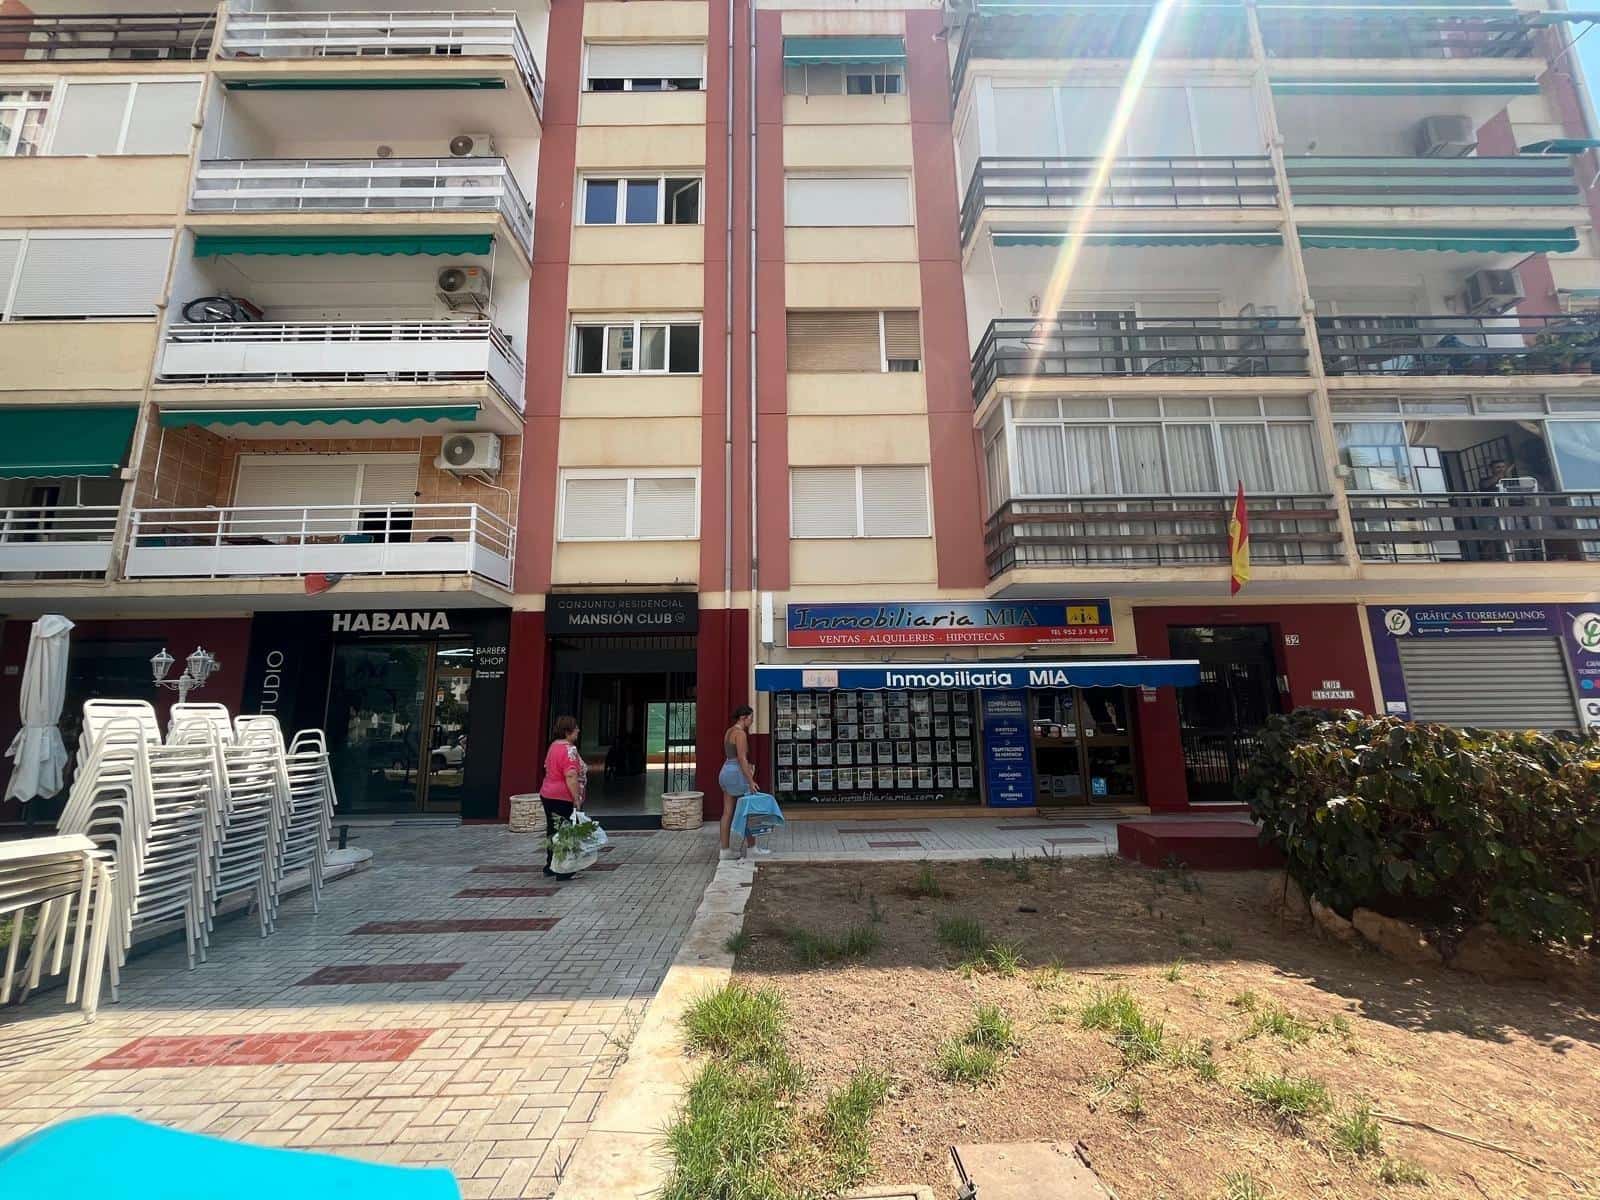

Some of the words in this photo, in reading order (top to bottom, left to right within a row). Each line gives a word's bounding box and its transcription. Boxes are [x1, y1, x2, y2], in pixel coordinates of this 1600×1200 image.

[558, 600, 616, 610] CONJUNTO
[618, 599, 685, 609] RESIDENCIAL
[568, 610, 634, 625] MANSIÓN
[636, 613, 673, 625] CLUB
[794, 607, 974, 630] Inmobiliaria
[984, 607, 1037, 626] MIA
[1415, 610, 1464, 621] GRÁFICAS
[1466, 610, 1546, 621] TORREMOLINOS
[332, 612, 450, 632] HABANA
[819, 634, 861, 644] VENTAS
[868, 633, 935, 643] ALQUILERES
[946, 632, 1006, 642] HIPOTECAS
[1285, 634, 1300, 646] 32
[476, 646, 506, 655] BARBER
[480, 656, 504, 665] SHOP
[260, 650, 285, 715] TUDIO
[886, 670, 1012, 687] Inmobiliaria
[1028, 670, 1070, 686] MIA
